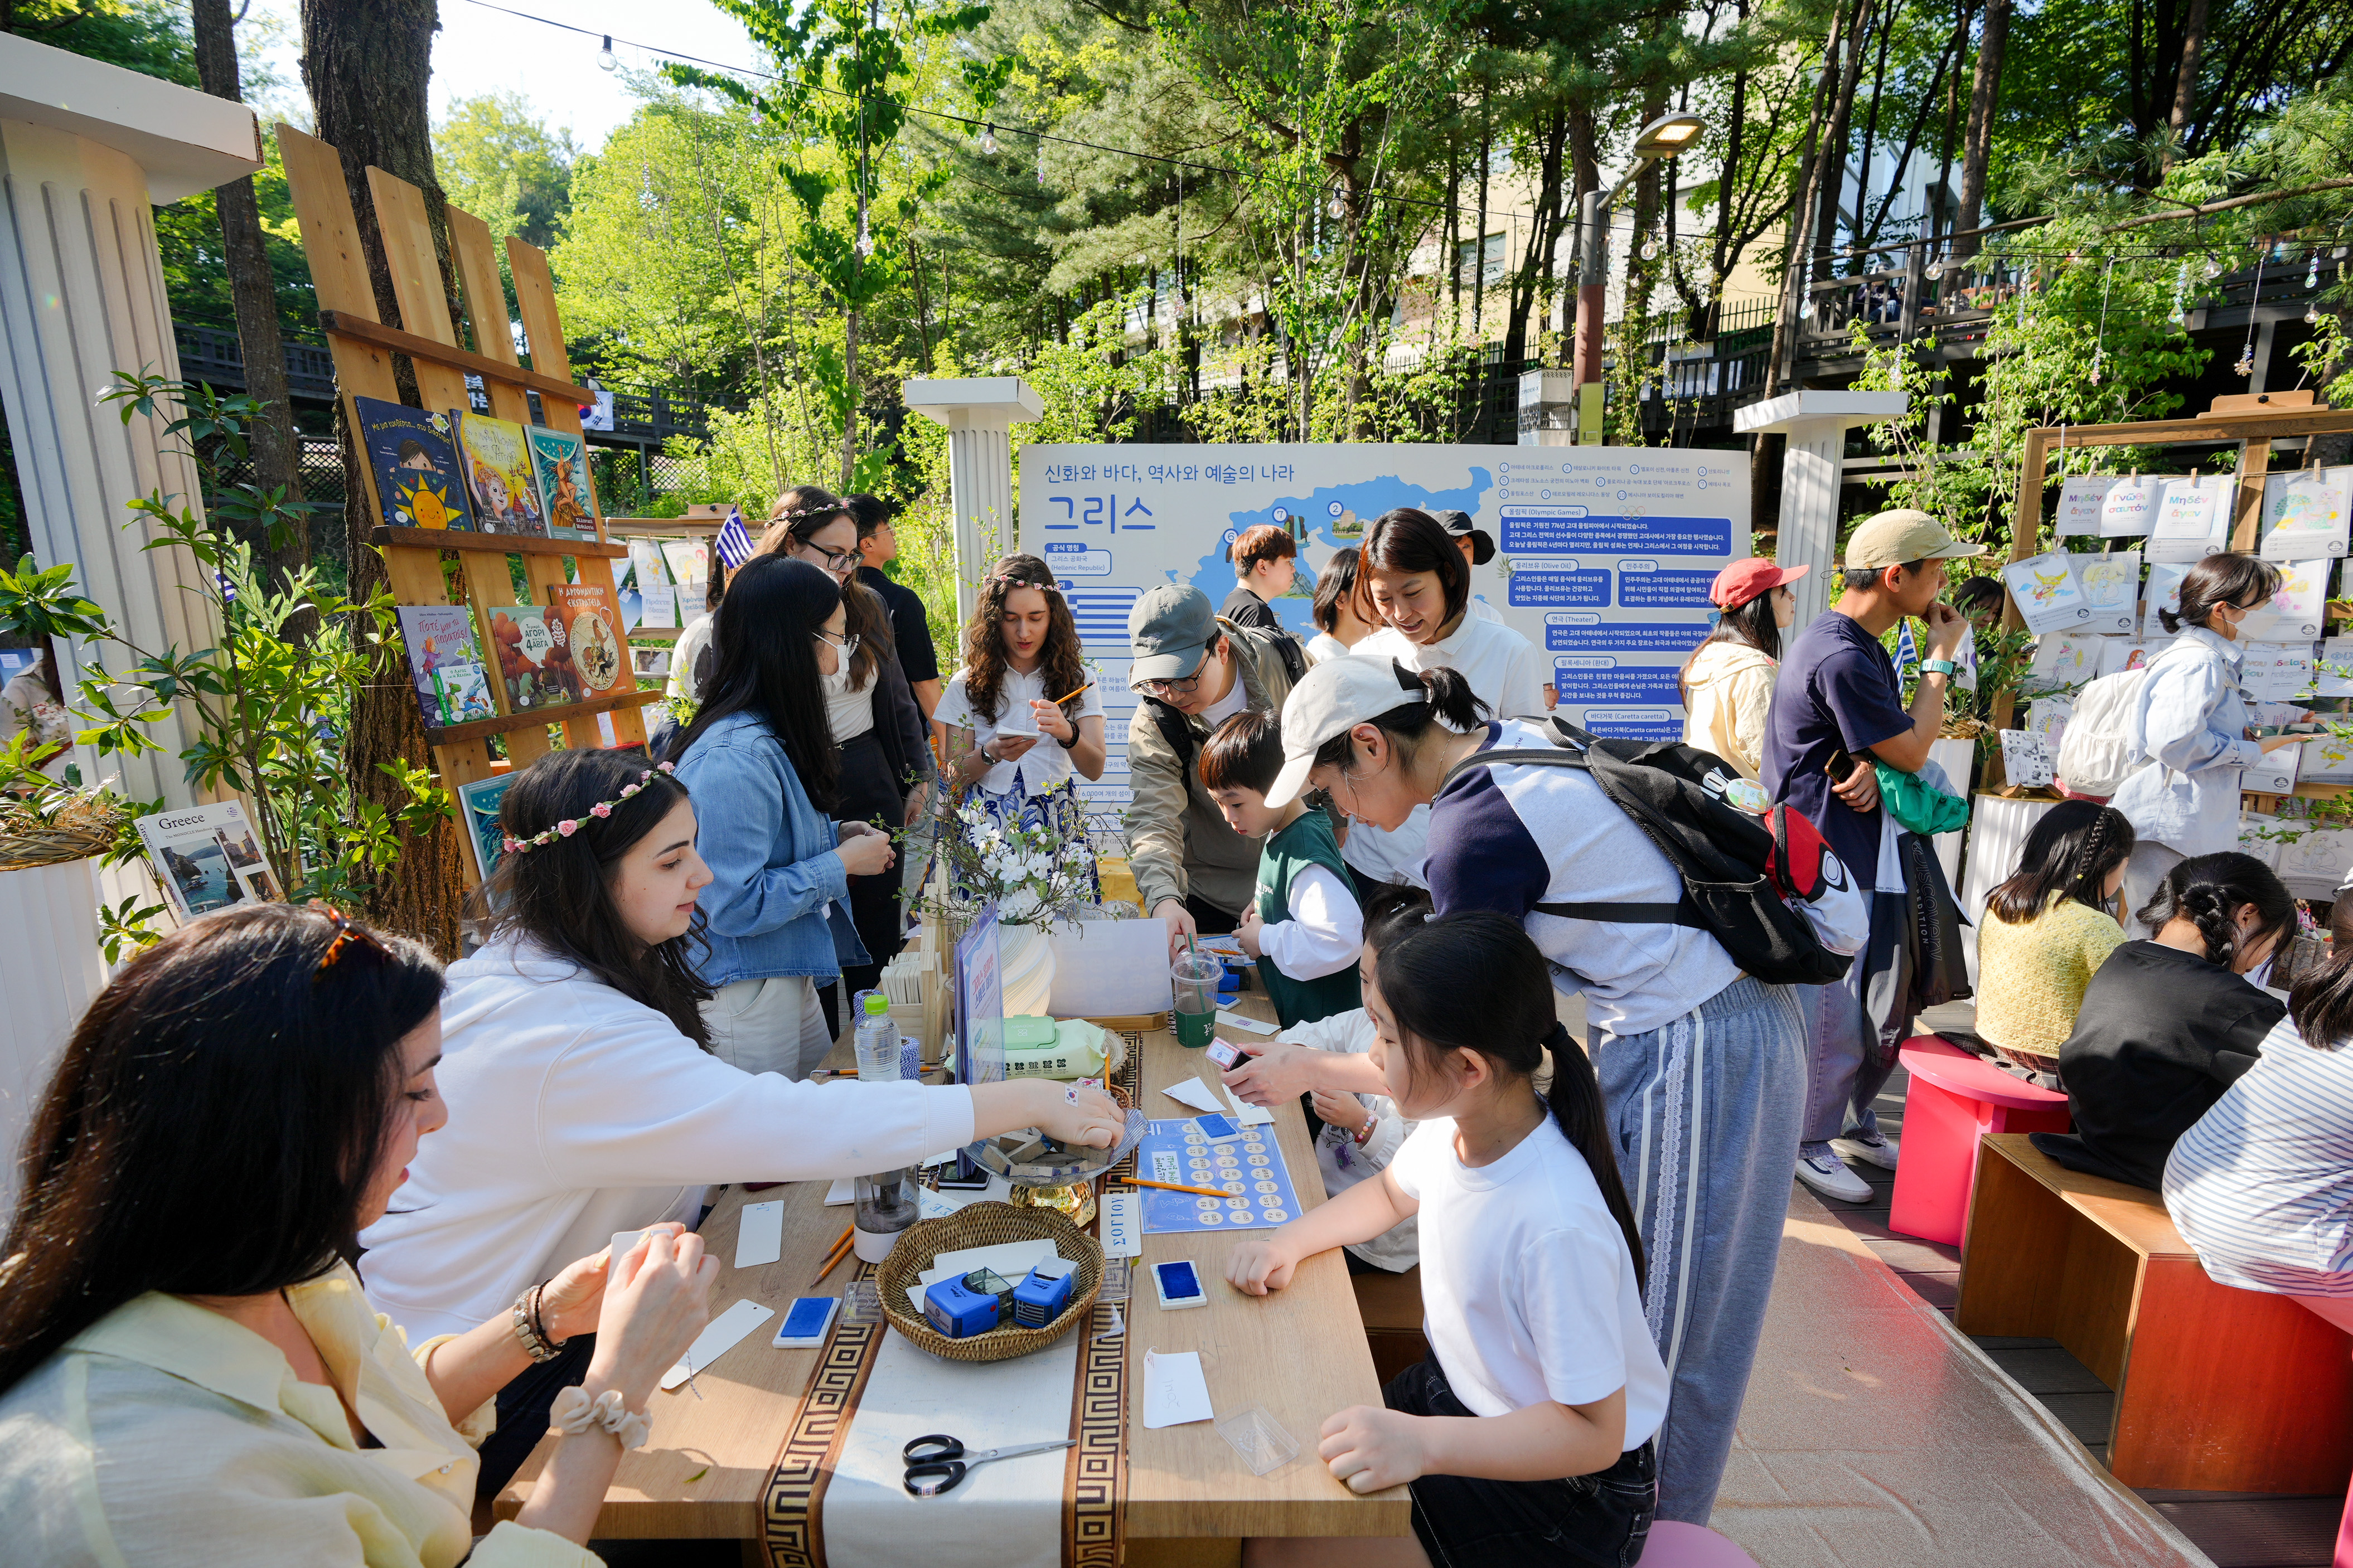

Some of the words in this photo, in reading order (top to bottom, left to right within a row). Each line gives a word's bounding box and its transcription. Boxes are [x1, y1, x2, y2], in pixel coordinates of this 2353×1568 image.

[1044, 464, 1097, 483] 신화와
[1103, 464, 1142, 484] 바다,
[1148, 463, 1199, 484] 역사와
[1204, 464, 1255, 484] 예술의
[1261, 464, 1295, 482] 나라
[2069, 493, 2103, 503] Μηδέν
[2169, 496, 2209, 504] Μηδέν
[1044, 494, 1156, 534] 그리스
[418, 619, 439, 633] Ποτέ
[452, 619, 460, 627] τα
[526, 639, 533, 651] 4
[158, 813, 205, 830] Greece
[139, 823, 154, 849] Greece
[173, 829, 195, 838] MONOCLE
[1913, 852, 1942, 961] Discovery
